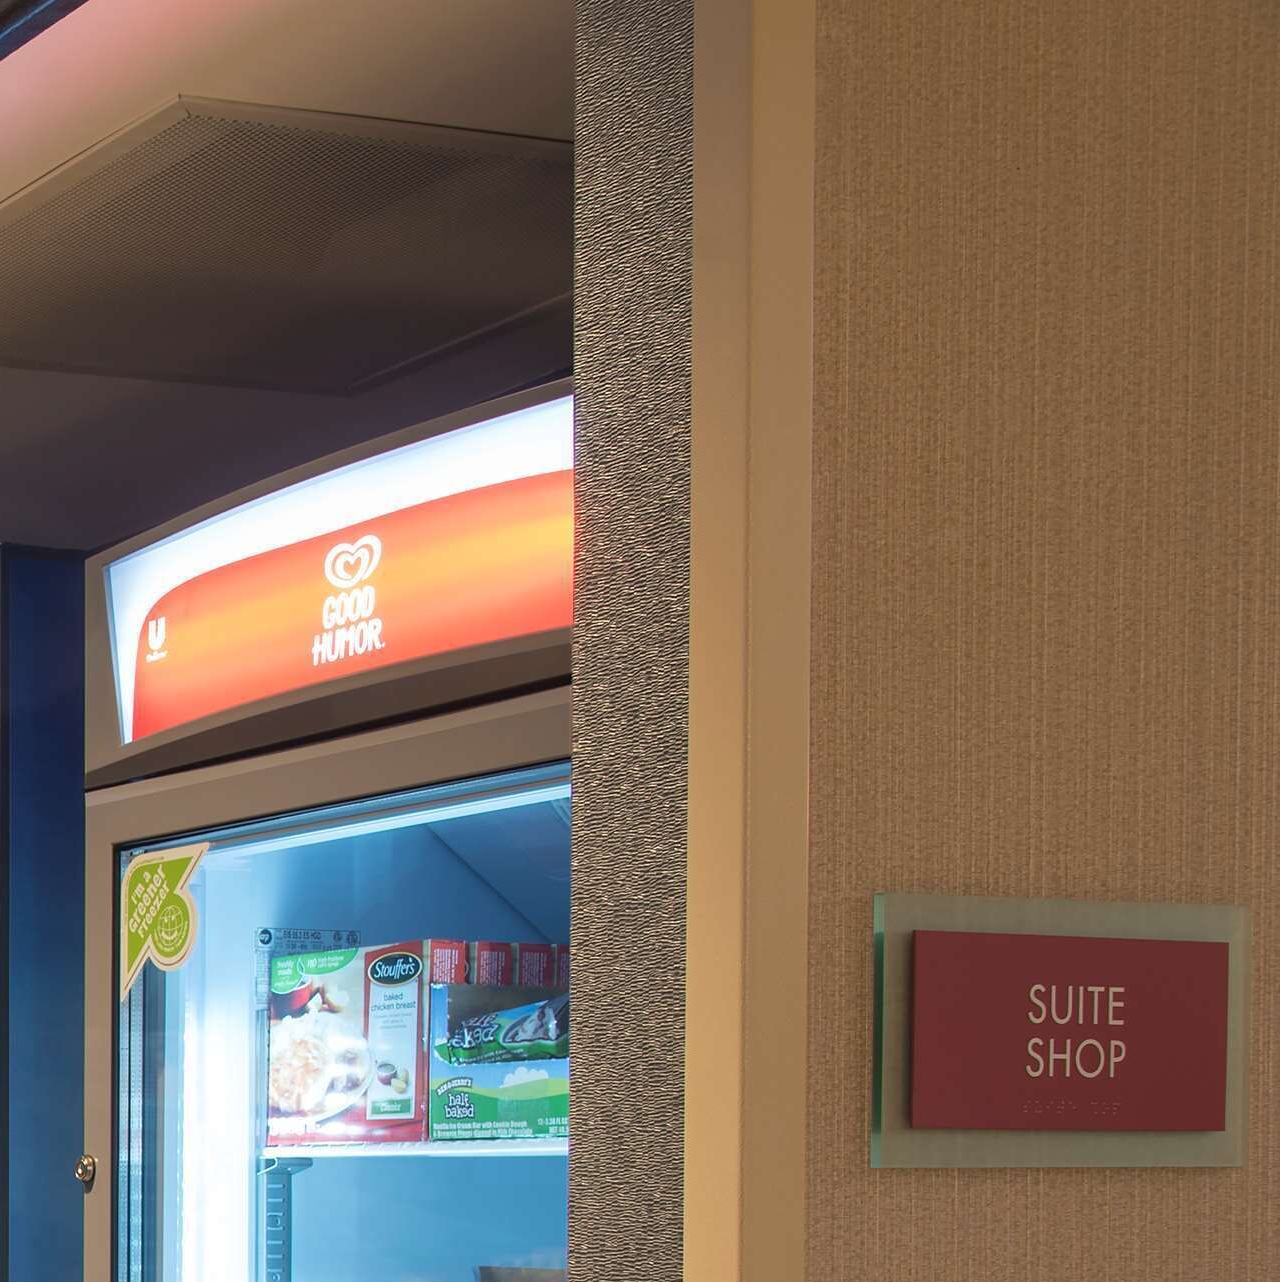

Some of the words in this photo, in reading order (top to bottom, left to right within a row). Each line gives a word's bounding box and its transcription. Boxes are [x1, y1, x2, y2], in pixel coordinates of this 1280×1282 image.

[322, 584, 376, 629] GOOD
[311, 617, 385, 666] HUMOR
[373, 957, 415, 980] Stouffer's
[1027, 984, 1126, 1026] SUITE
[1025, 1037, 1127, 1079] SHOP
[445, 1104, 474, 1118] baked
[449, 1093, 470, 1106] half
